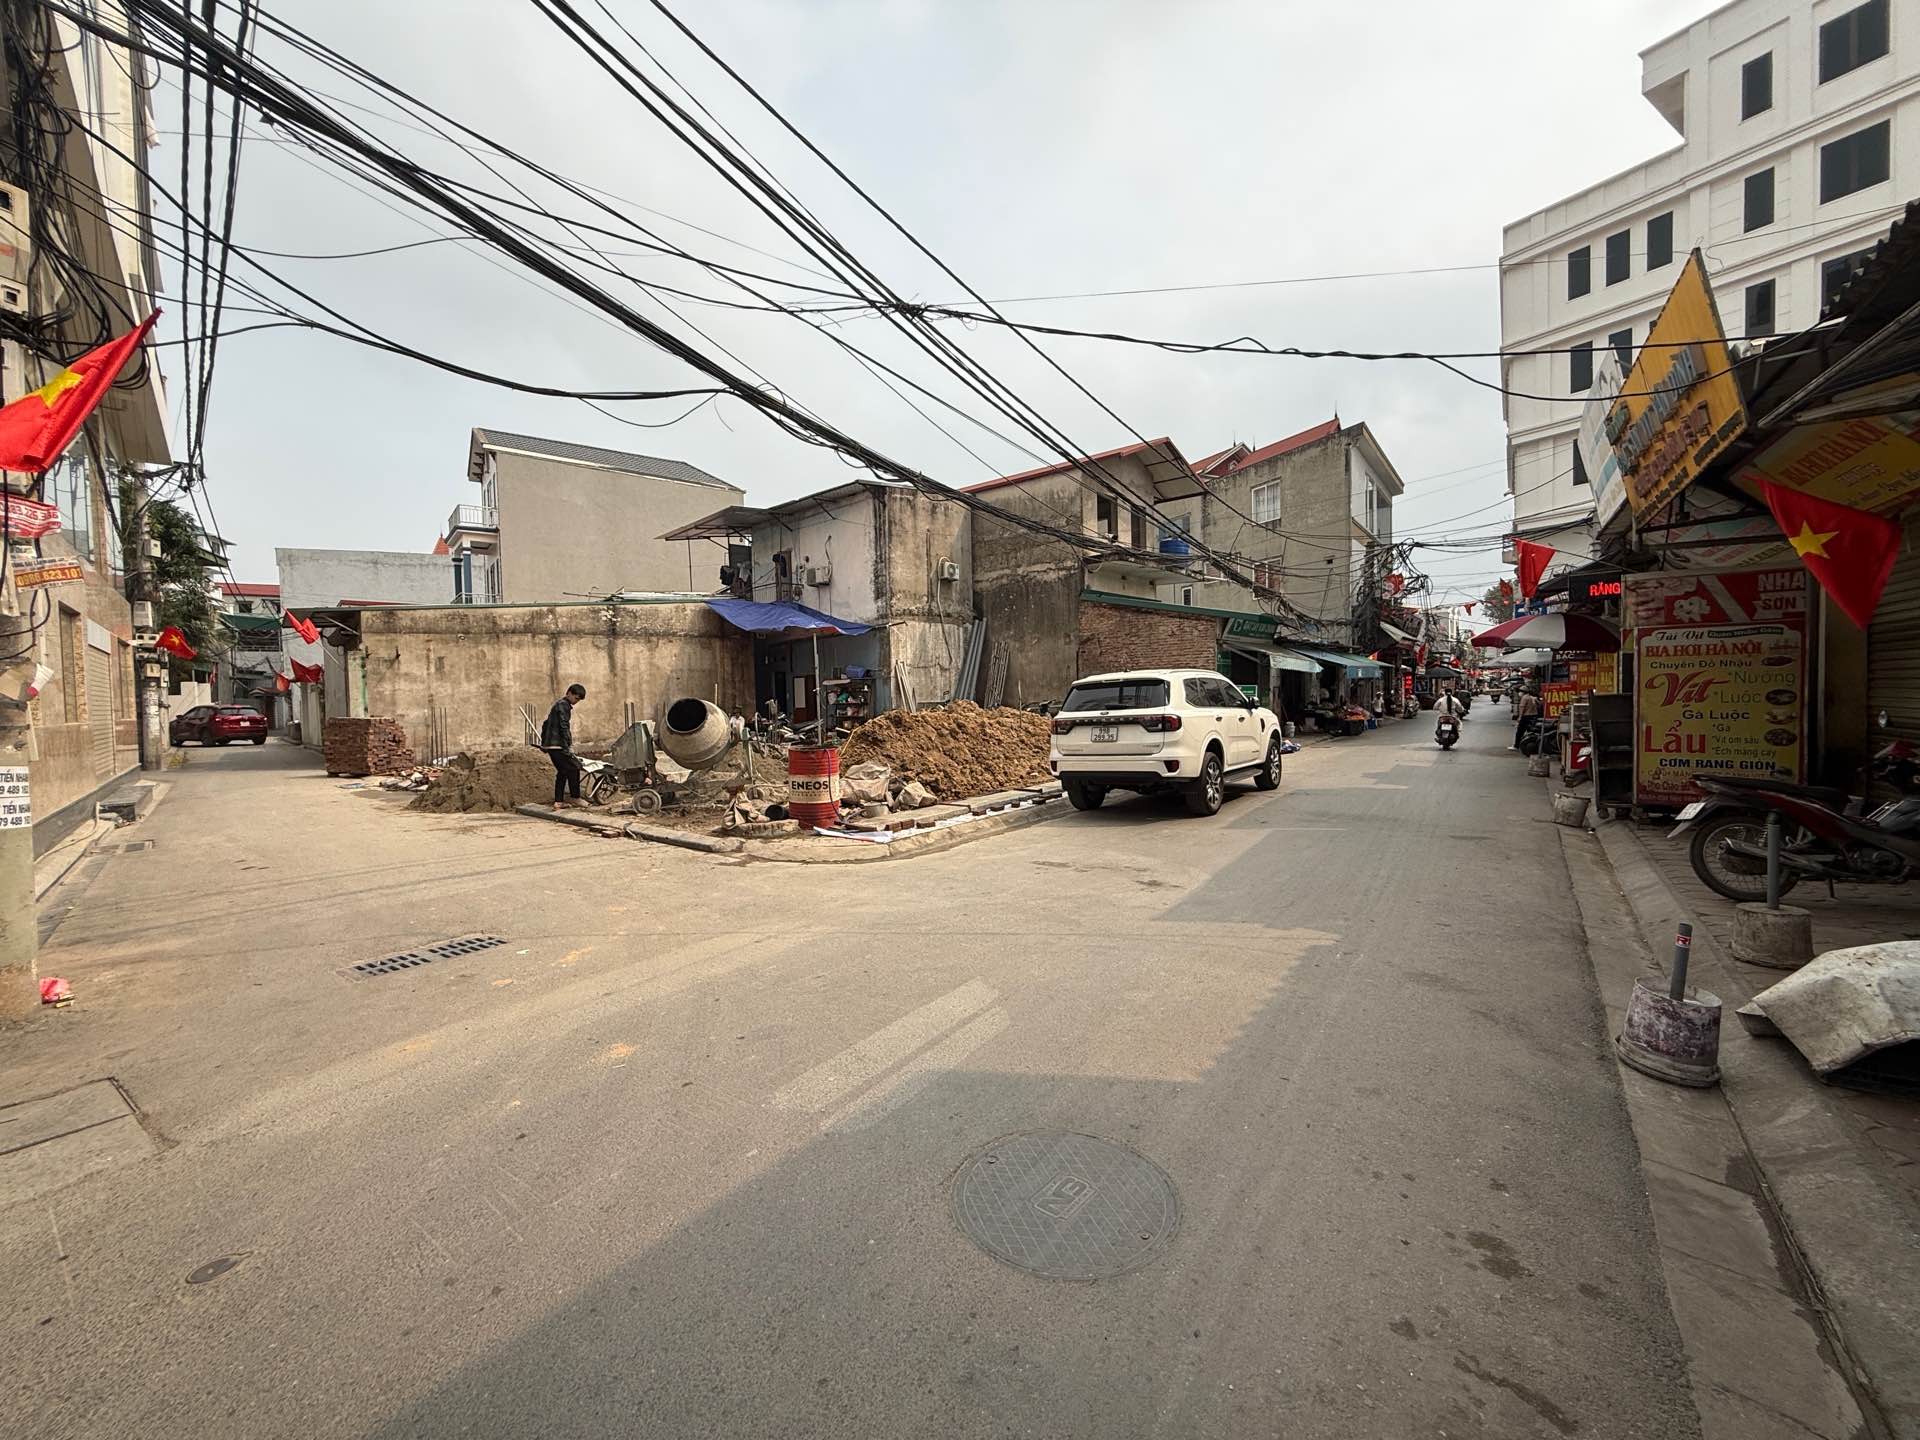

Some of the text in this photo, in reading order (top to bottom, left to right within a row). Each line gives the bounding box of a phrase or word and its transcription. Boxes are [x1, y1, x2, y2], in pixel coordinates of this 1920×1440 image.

[1589, 581, 1621, 597] RĂNG
[1761, 596, 1797, 611] SƠN
[1646, 645, 1670, 657] BIA
[1644, 719, 1707, 754] Lẩu
[1695, 758, 1735, 769] RANG
[791, 780, 829, 791] ENEOS
